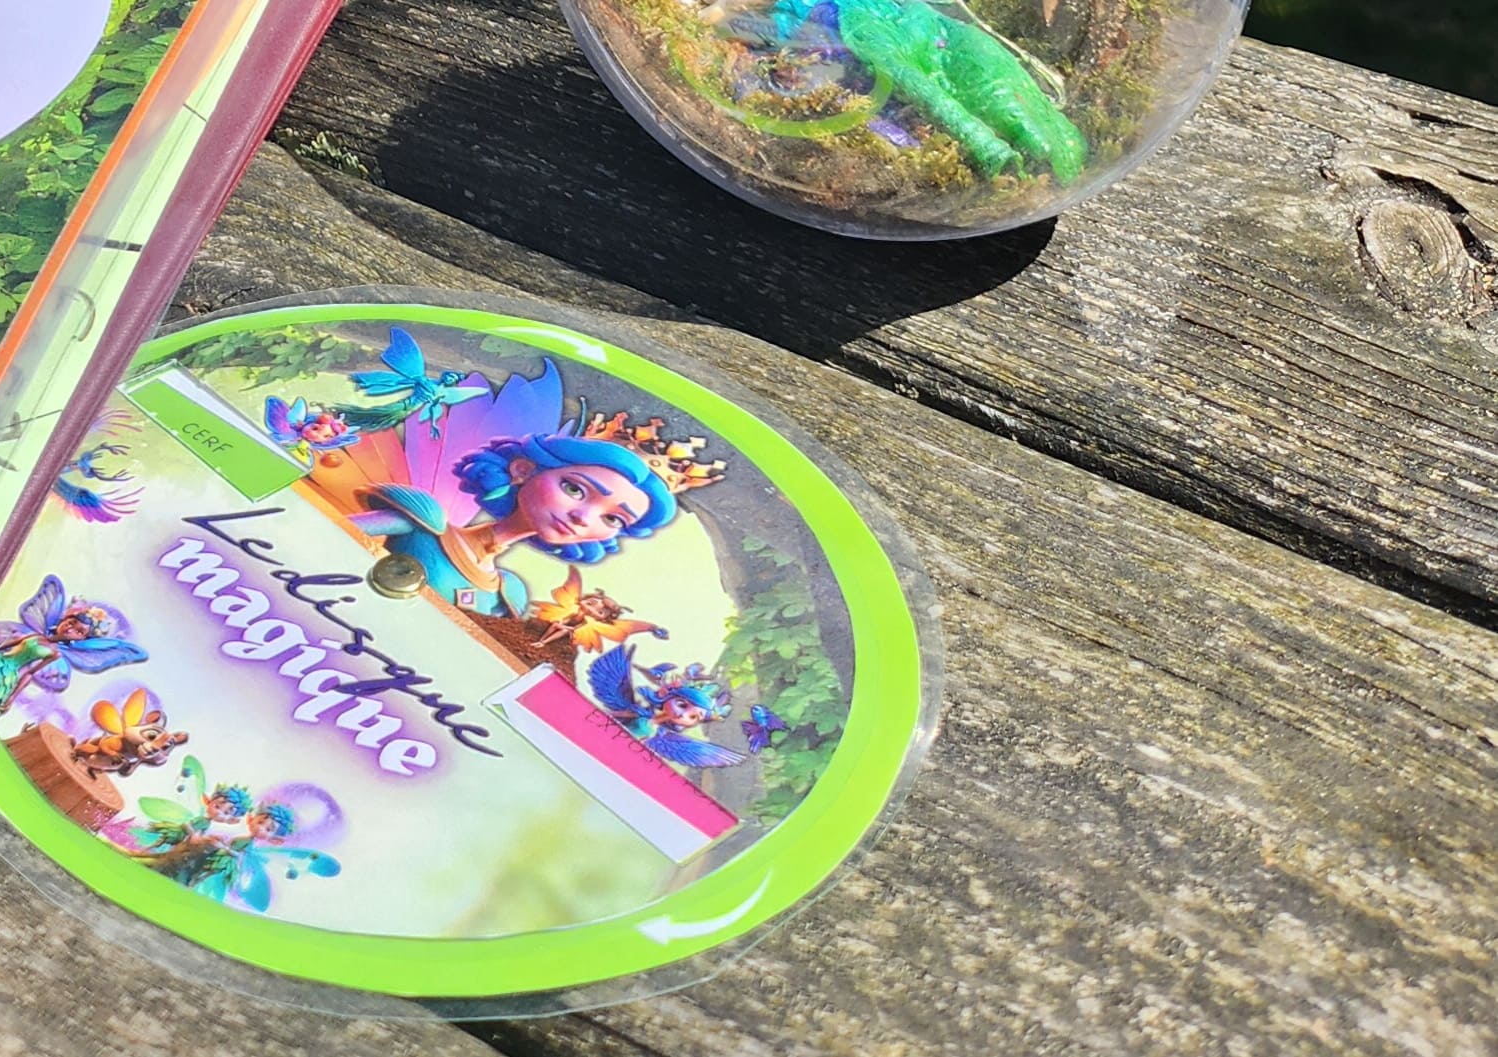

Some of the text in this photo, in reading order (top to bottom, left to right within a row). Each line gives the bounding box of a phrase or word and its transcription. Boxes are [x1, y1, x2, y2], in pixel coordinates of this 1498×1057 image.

[181, 422, 234, 453] CERF
[157, 536, 438, 777] magique
[181, 506, 504, 758] Le disque
